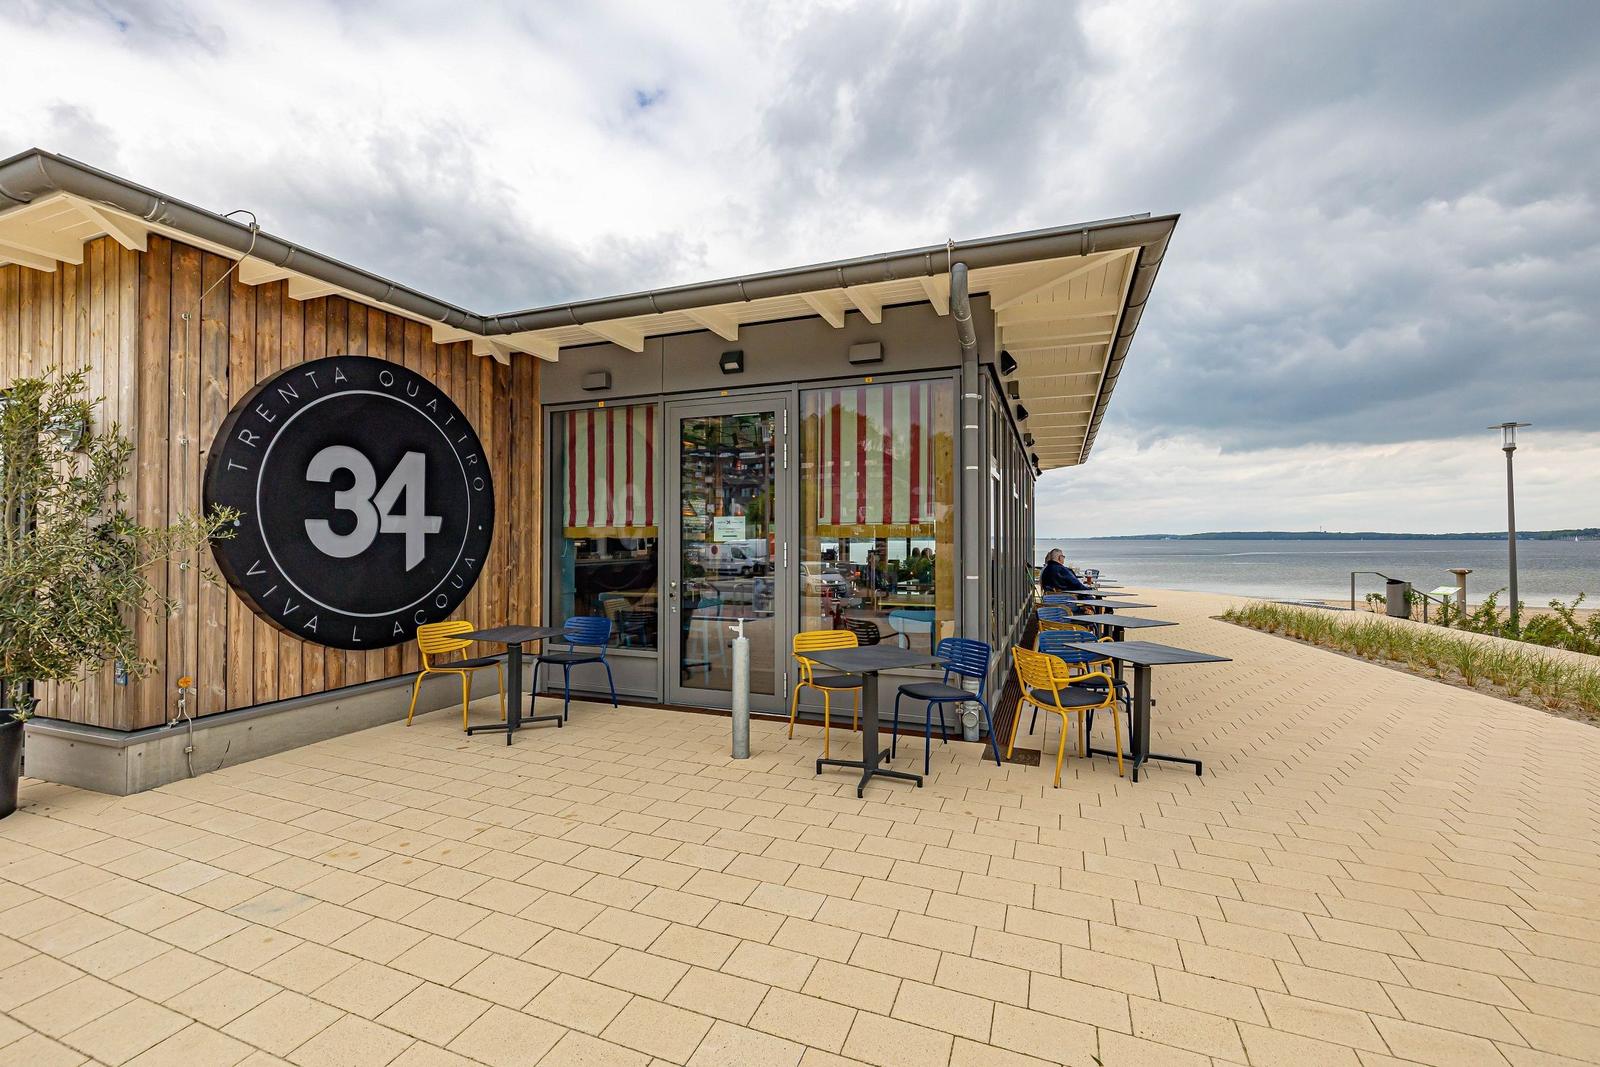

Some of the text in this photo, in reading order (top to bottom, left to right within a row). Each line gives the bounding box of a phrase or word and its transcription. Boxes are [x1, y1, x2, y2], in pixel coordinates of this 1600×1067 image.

[227, 366, 485, 492] TRENTA QUATTRO
[304, 444, 443, 573] 34
[246, 559, 319, 633] VIVA
